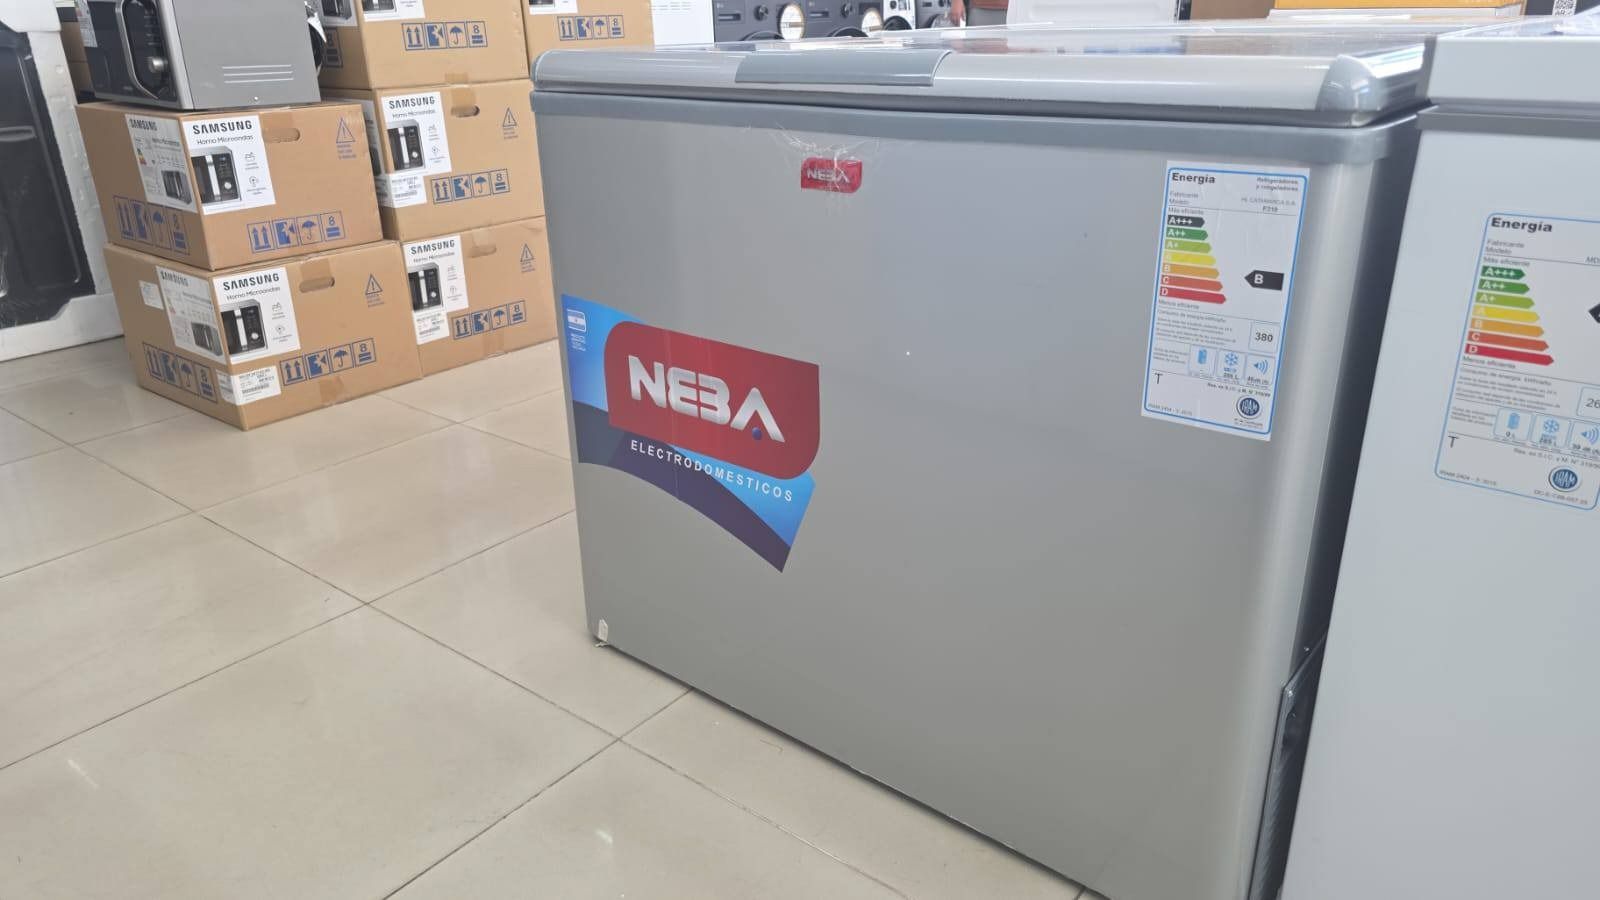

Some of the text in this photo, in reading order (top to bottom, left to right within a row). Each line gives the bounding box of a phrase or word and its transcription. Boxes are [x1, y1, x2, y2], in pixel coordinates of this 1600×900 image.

[388, 96, 435, 109] SAMSUNG
[129, 119, 158, 131] SAMSUNG
[192, 120, 253, 135] SAMSUNG
[197, 134, 254, 145] Horno Microondas
[1168, 216, 1193, 225] A+++
[1167, 229, 1186, 237] A++
[411, 240, 455, 255] SAMSUNG
[1166, 241, 1179, 249] A+
[1484, 267, 1516, 277] A+++
[223, 273, 279, 291] SAMSUNG
[1162, 276, 1169, 284] C
[1254, 274, 1264, 285] B
[1482, 280, 1506, 289] A++
[1161, 288, 1168, 296] D
[1479, 293, 1496, 303] A+
[1255, 332, 1274, 343] 380
[1471, 332, 1480, 341] C
[1468, 345, 1478, 353] D
[1154, 372, 1164, 385] T
[628, 354, 786, 443] NEBA
[1448, 435, 1459, 448] T
[631, 439, 793, 502] ELECTRODOMESTICOS
